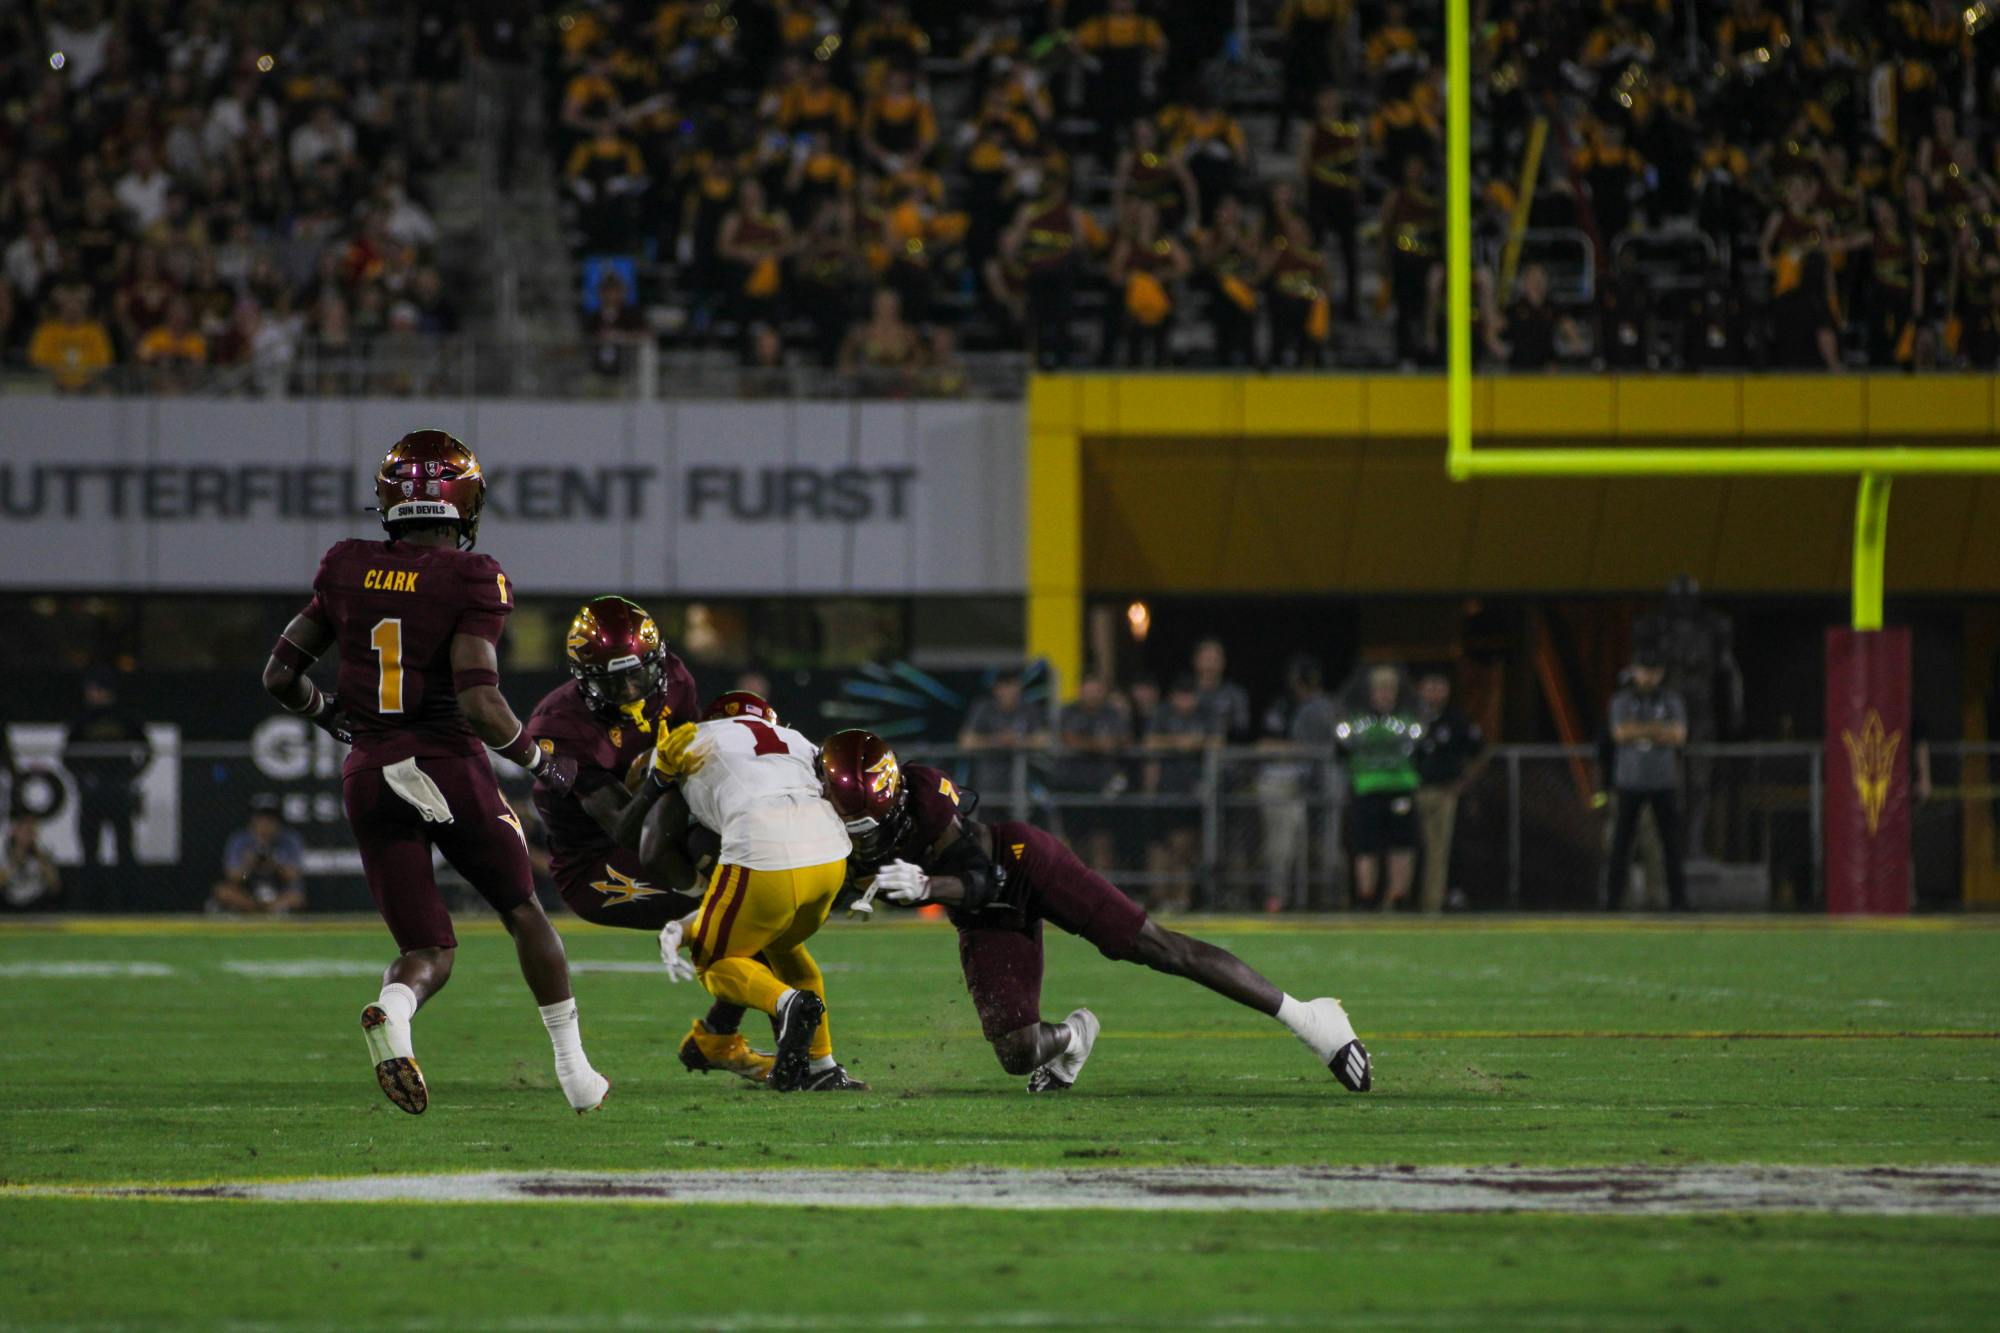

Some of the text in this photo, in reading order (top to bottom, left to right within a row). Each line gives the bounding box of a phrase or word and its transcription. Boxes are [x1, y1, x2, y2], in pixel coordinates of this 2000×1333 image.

[0, 464, 380, 522] UTTERFIEL
[685, 464, 917, 523] FURST
[398, 504, 446, 517] SUN DEVILS
[363, 569, 420, 593] CLARK
[370, 617, 404, 714] 1
[732, 719, 790, 756] 1
